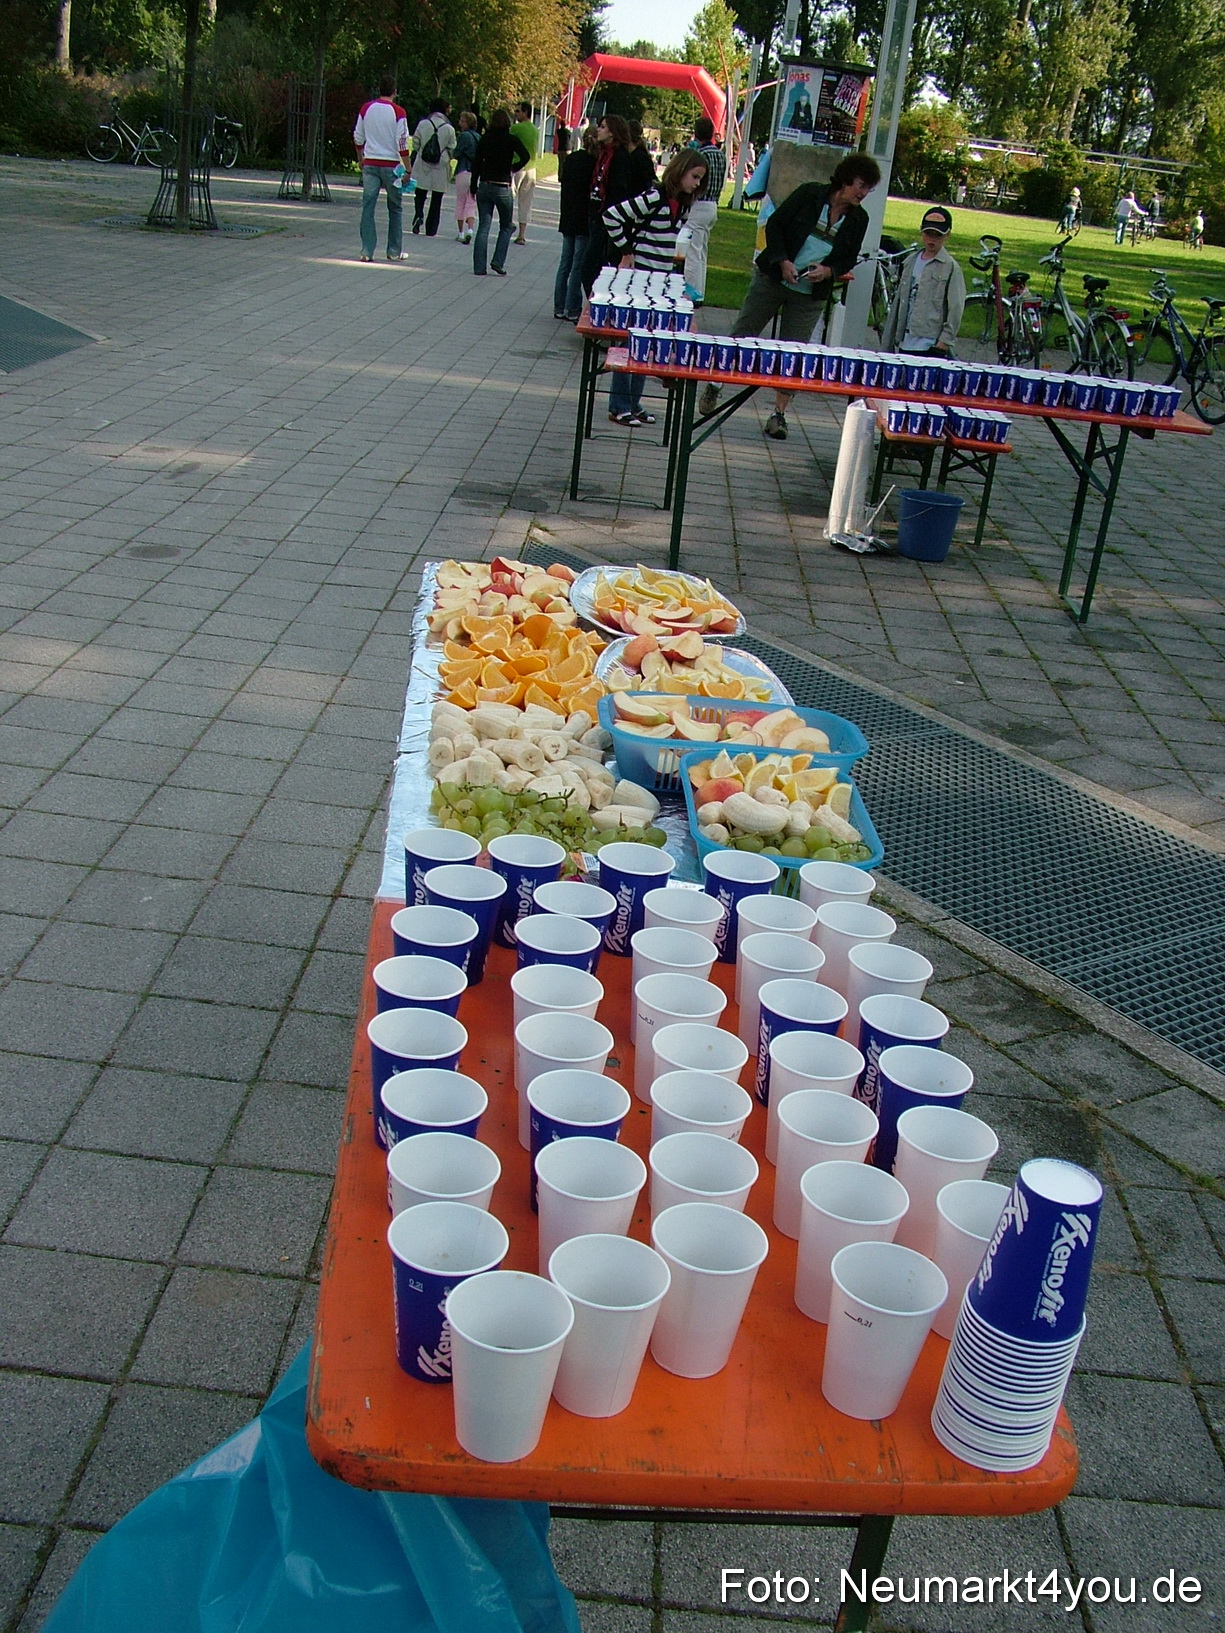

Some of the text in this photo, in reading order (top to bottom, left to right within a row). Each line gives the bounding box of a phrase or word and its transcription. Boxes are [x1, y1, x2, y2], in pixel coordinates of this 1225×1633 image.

[604, 883, 634, 953] Xenofit
[755, 1017, 769, 1100] Xenofit
[1037, 1211, 1092, 1326] Xenofit
